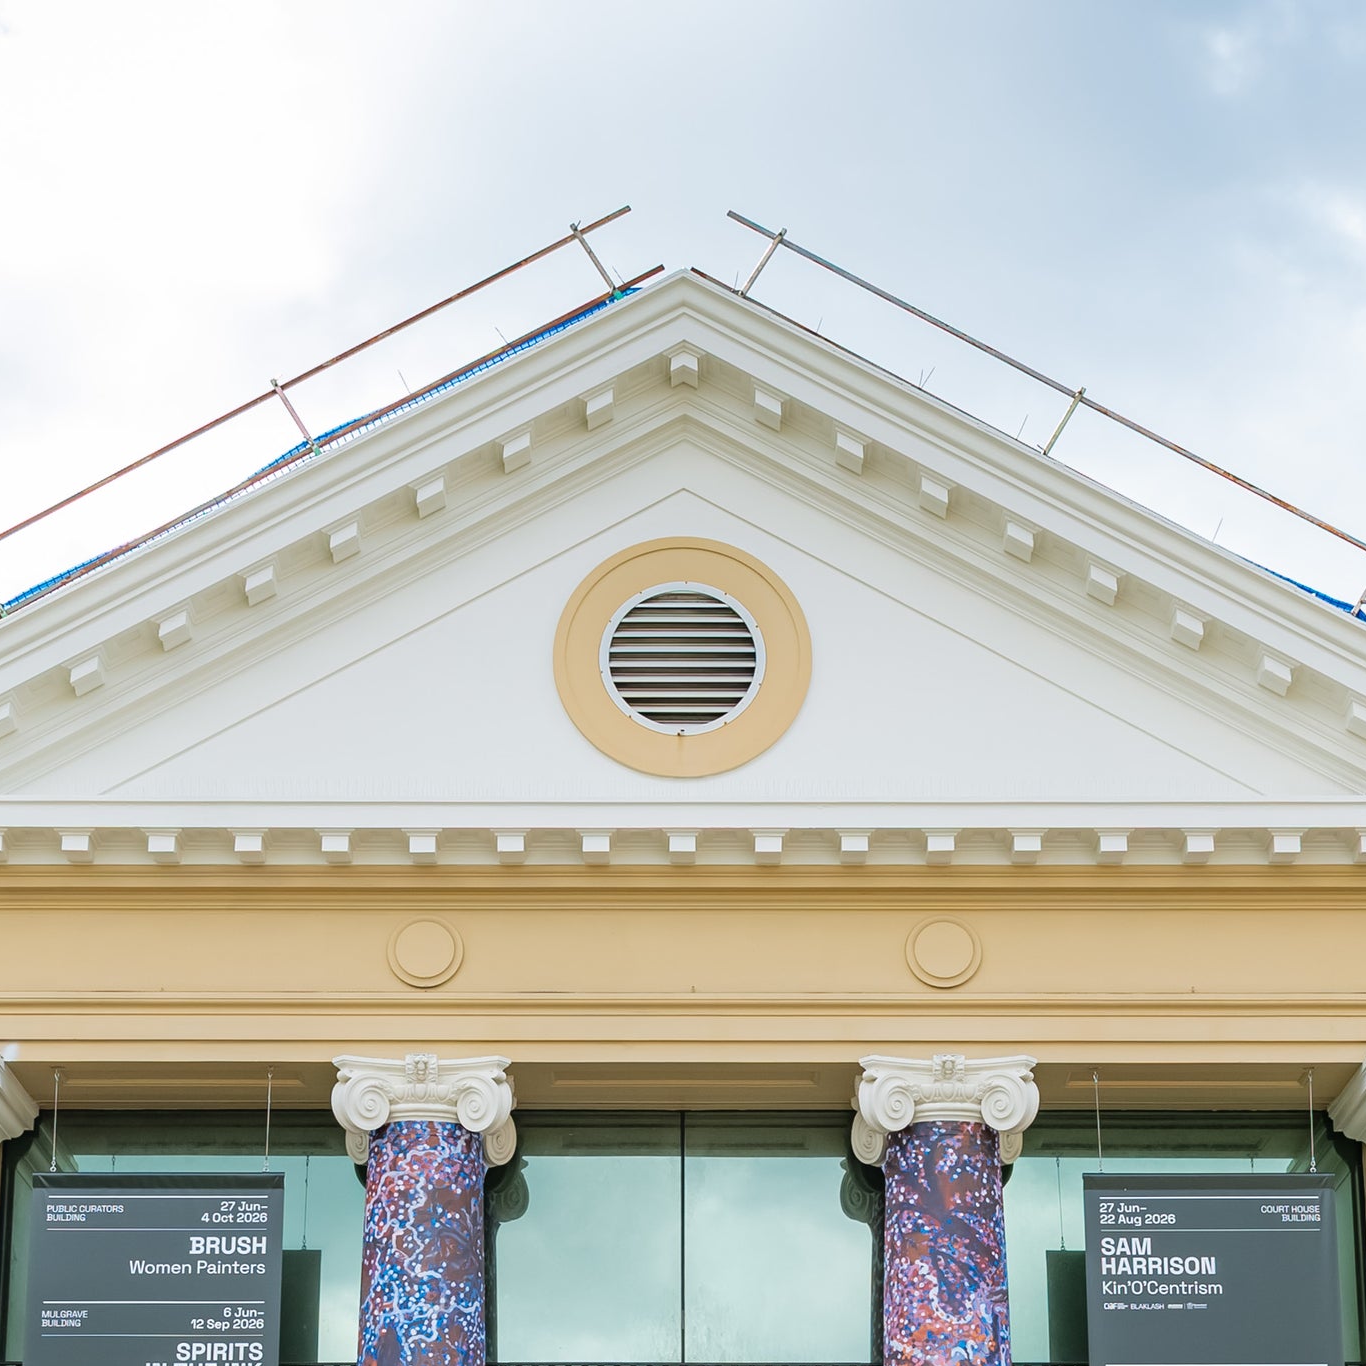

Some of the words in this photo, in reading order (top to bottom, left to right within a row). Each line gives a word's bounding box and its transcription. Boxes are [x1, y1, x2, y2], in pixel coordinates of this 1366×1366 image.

[46, 1204, 77, 1213] PUBLIC
[78, 1204, 124, 1213] CURATORS
[220, 1201, 236, 1211] 27
[1099, 1203, 1115, 1213] 27
[1261, 1205, 1290, 1213] COURT
[1291, 1205, 1320, 1213] HOUSE
[46, 1213, 86, 1222] BUILDING
[201, 1213, 210, 1223] 4
[212, 1213, 234, 1223] Oct
[236, 1213, 268, 1223] 2026
[1100, 1214, 1115, 1224] 22
[1117, 1214, 1142, 1226] Aug
[1144, 1214, 1176, 1224] 2026
[1281, 1213, 1321, 1222] BUILDING
[189, 1236, 267, 1255] BRUSH
[1100, 1237, 1151, 1256] SAM
[129, 1260, 192, 1274] Women
[197, 1260, 266, 1274] Painters
[1101, 1257, 1216, 1275] HARRISON
[42, 1310, 88, 1319] MULGRAVE
[223, 1307, 232, 1317] 6
[41, 1319, 81, 1327] BUILDING
[191, 1319, 205, 1329] 12
[206, 1319, 230, 1331] Sep
[233, 1319, 264, 1329] 2026
[176, 1342, 263, 1361] SPIRITS
